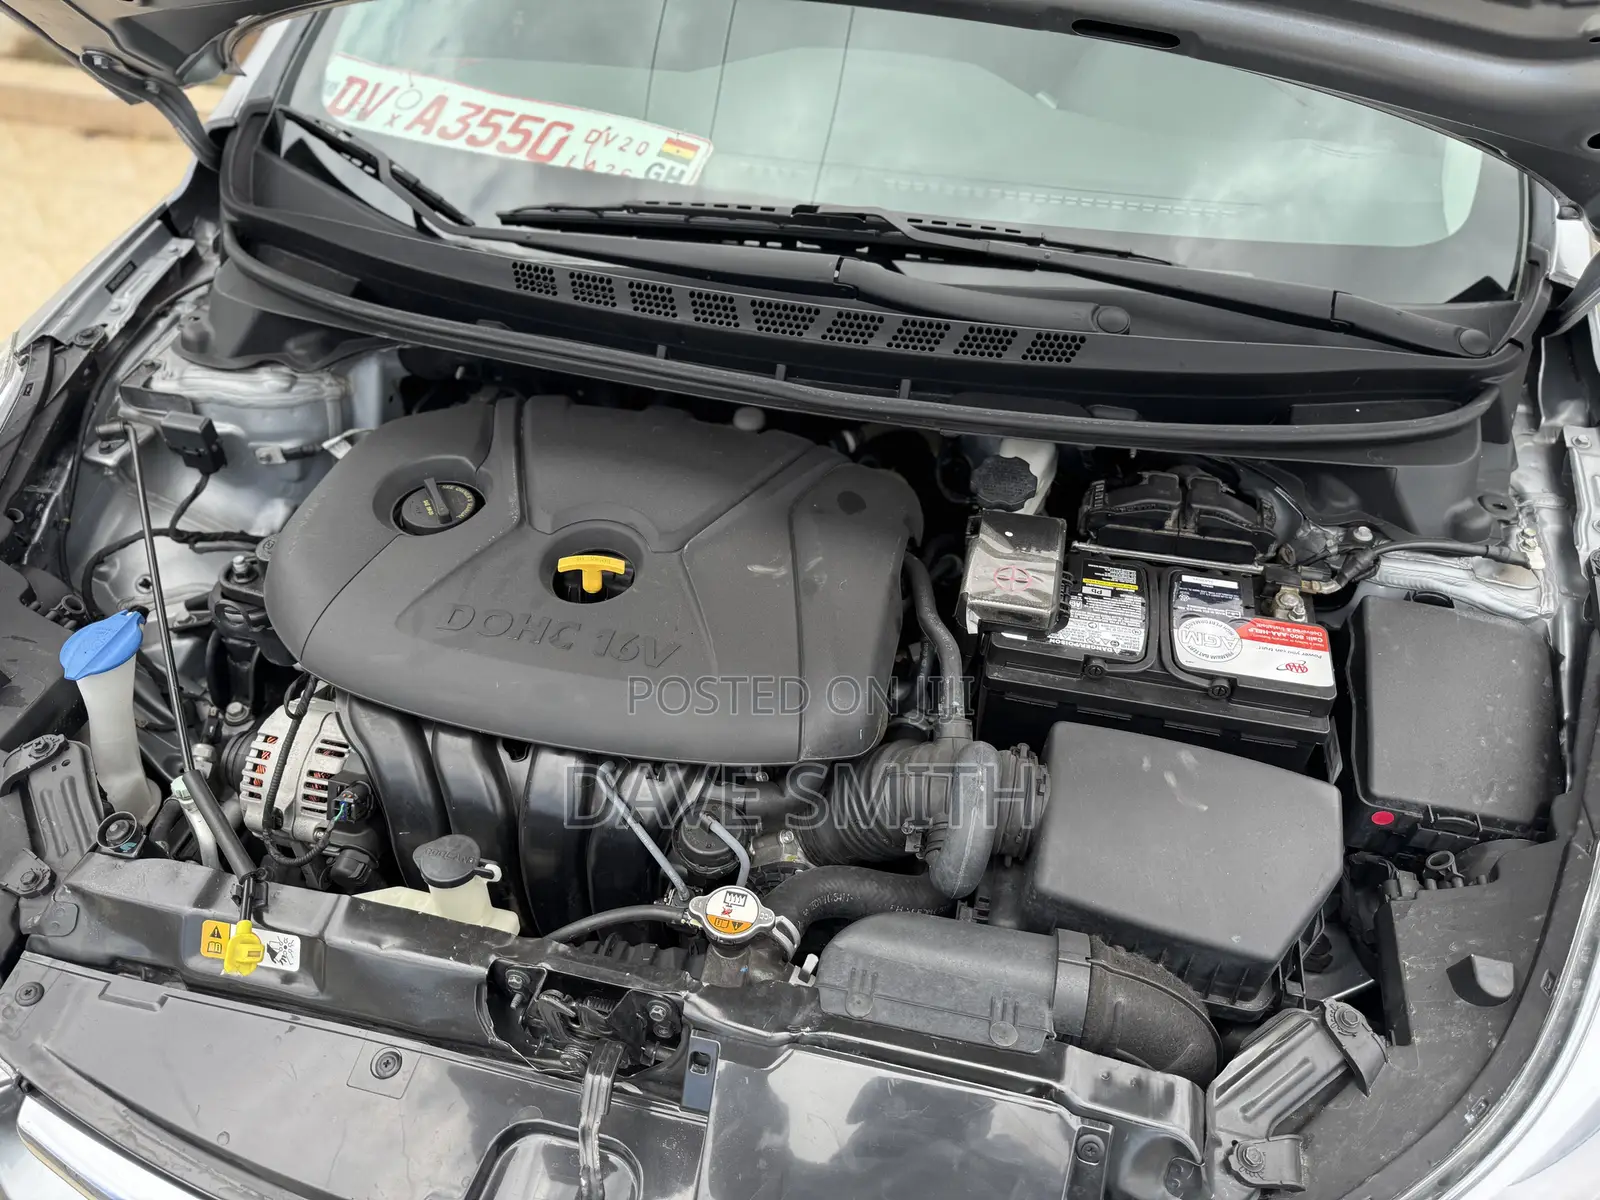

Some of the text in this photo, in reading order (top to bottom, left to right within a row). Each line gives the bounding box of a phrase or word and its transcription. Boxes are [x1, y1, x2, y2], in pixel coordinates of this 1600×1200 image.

[327, 75, 574, 163] DV A3550
[644, 162, 686, 183] GH
[436, 604, 682, 669] DOHC 16V
[1181, 629, 1239, 651] AGM
[1248, 627, 1305, 640] 800-AAA-HELP
[1306, 635, 1323, 643] Call:
[1188, 645, 1234, 660] PREMIUM BATTERY
[1285, 662, 1308, 673] AAA
[423, 847, 478, 865] COOLANT
